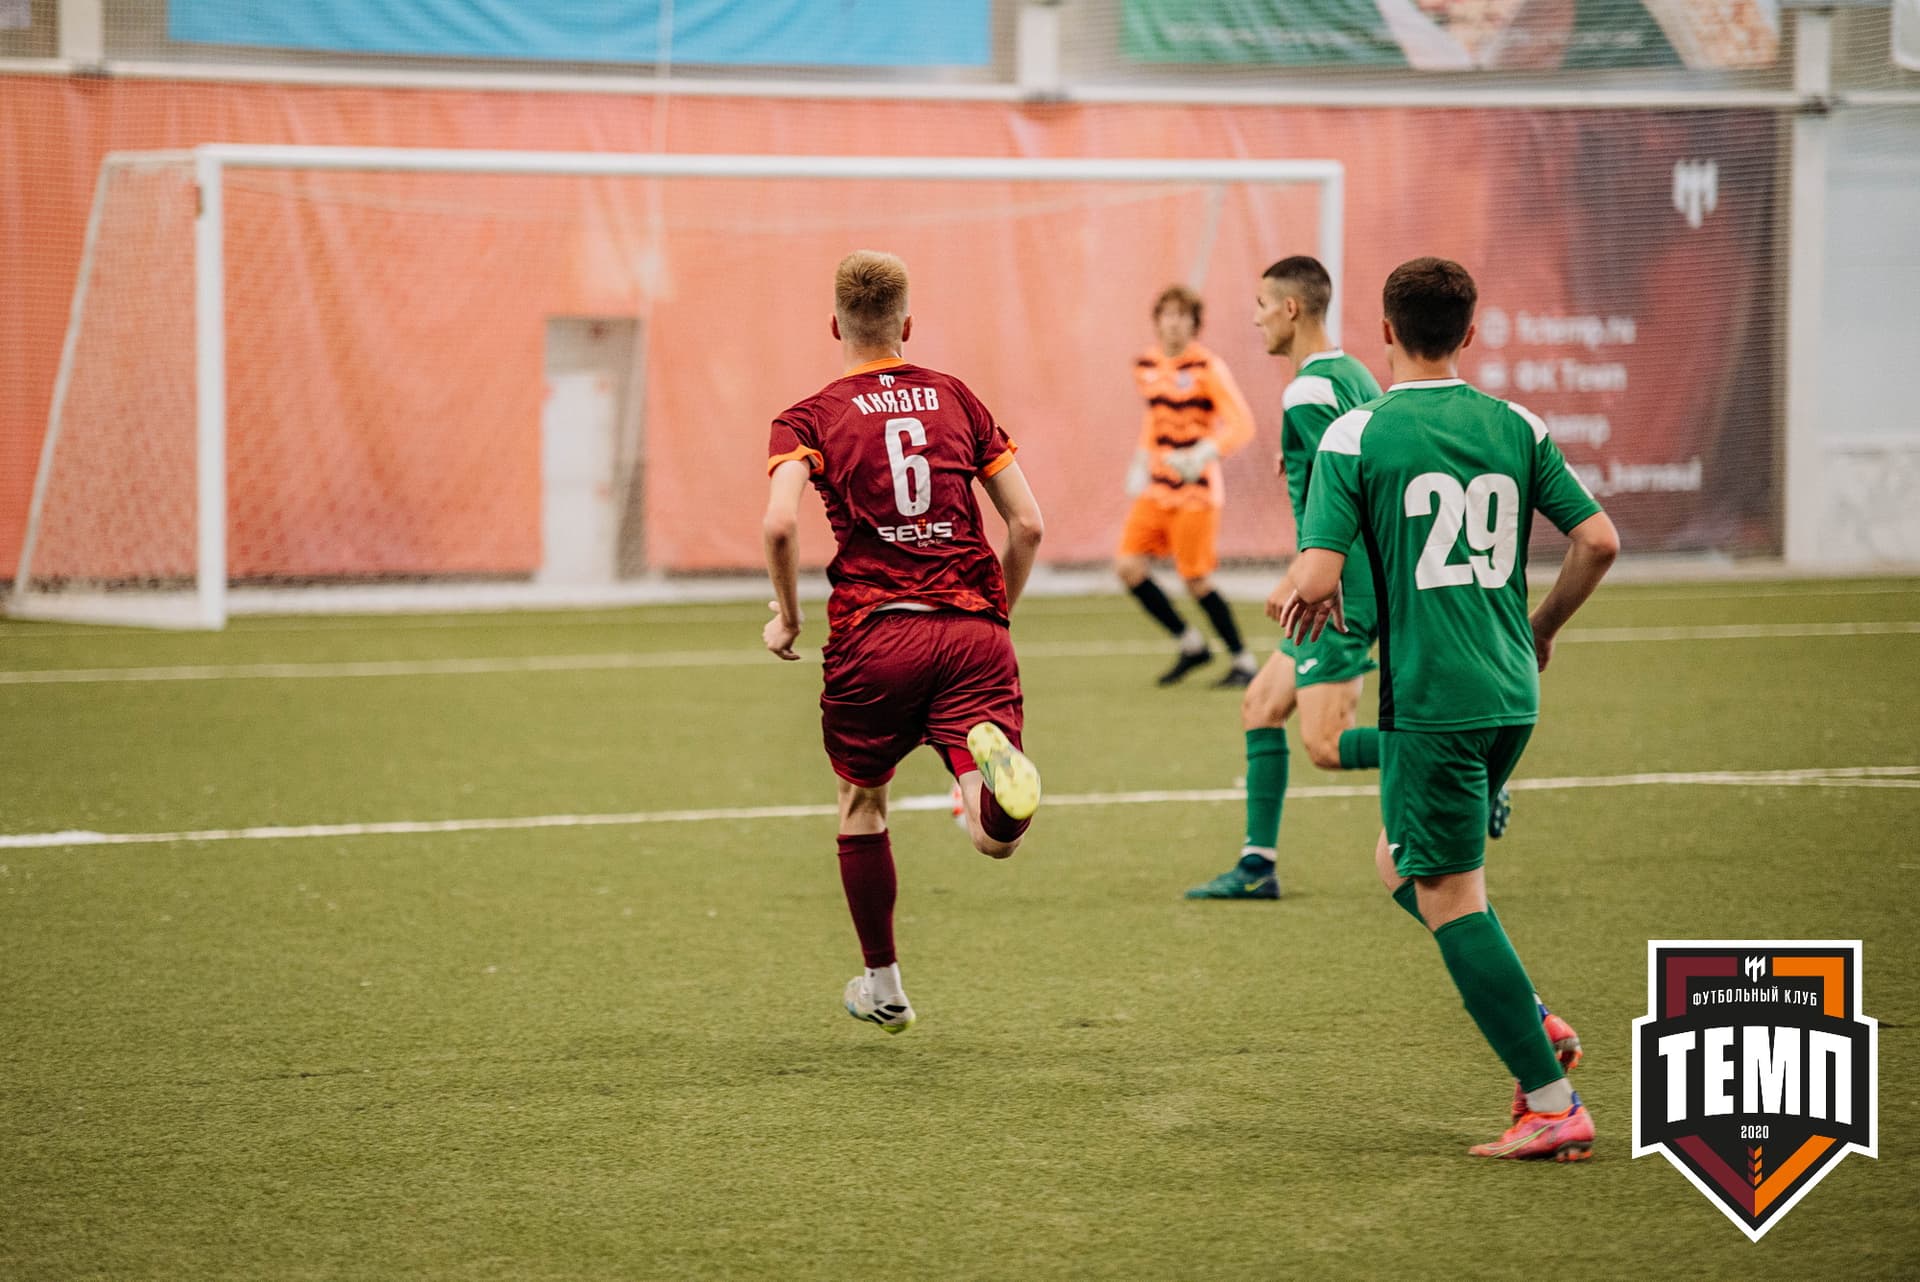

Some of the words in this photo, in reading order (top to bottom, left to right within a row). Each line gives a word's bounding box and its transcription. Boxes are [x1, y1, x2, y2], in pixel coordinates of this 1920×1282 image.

[851, 387, 940, 416] КНЯЗЕВ
[885, 417, 931, 517] 6
[1404, 472, 1519, 590] 29
